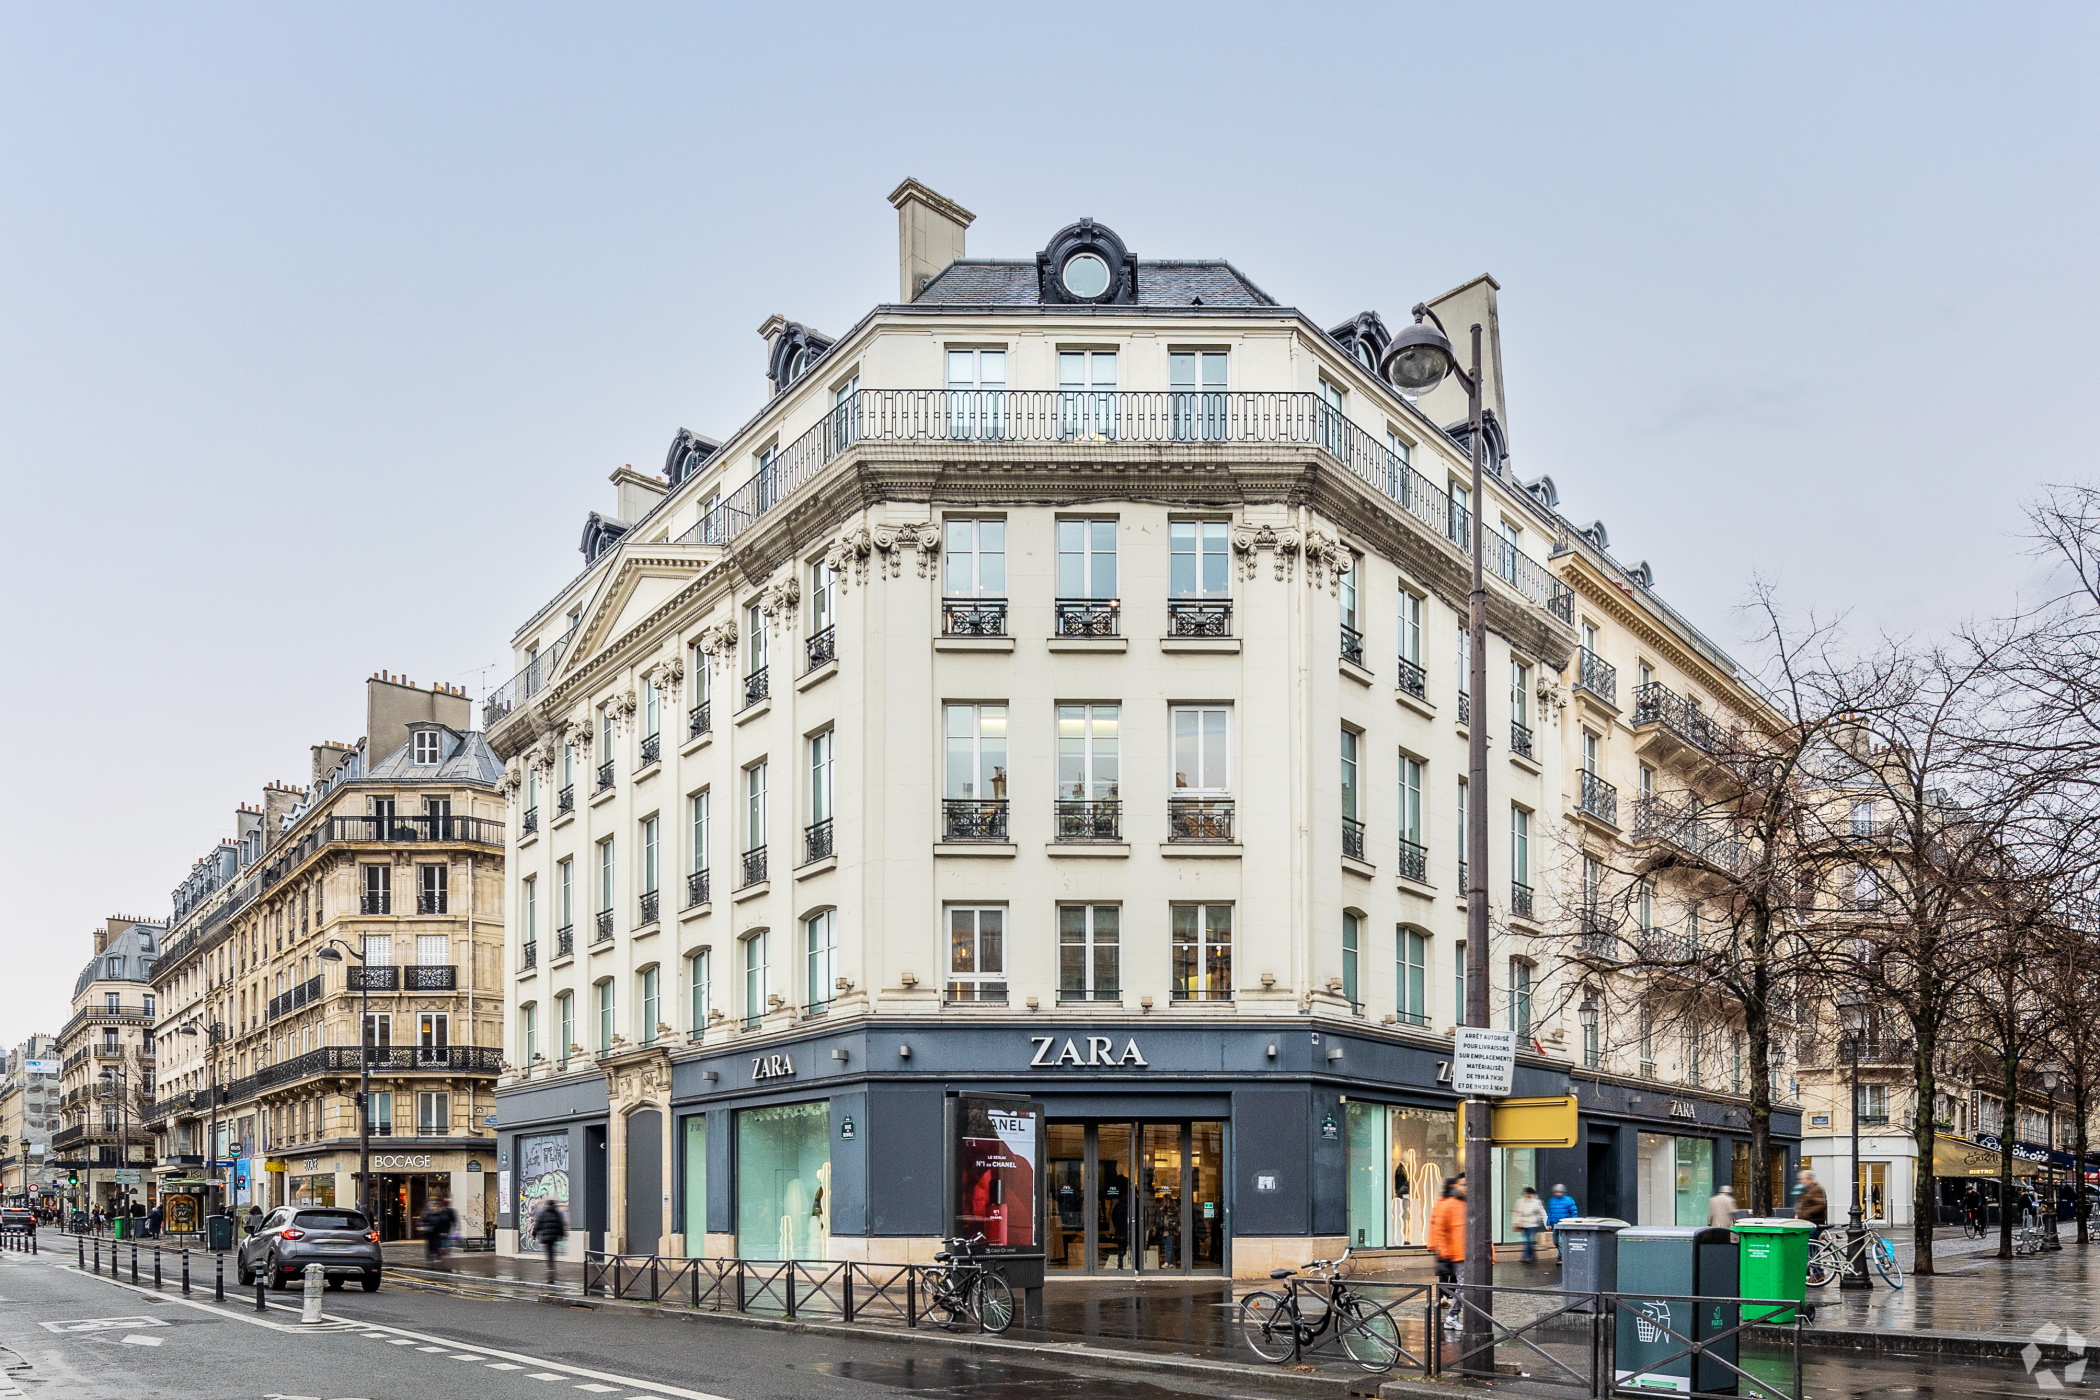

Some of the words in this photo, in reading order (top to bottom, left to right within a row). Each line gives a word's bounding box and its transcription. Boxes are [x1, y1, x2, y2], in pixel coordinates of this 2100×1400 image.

[1483, 1034, 1509, 1042] AUTORISÉ
[1030, 1036, 1149, 1066] ZARA
[1478, 1044, 1510, 1052] LIVRAISONS
[1470, 1053, 1513, 1062] EMPLACEMENTS
[752, 1054, 795, 1080] ZARA
[1466, 1063, 1505, 1071] MATÉRIALISÉS
[1669, 1100, 1696, 1118] ZARA
[991, 1118, 1026, 1131] ANEL
[374, 1155, 432, 1168] BOCAGE
[1711, 1319, 1723, 1327] PARIS
